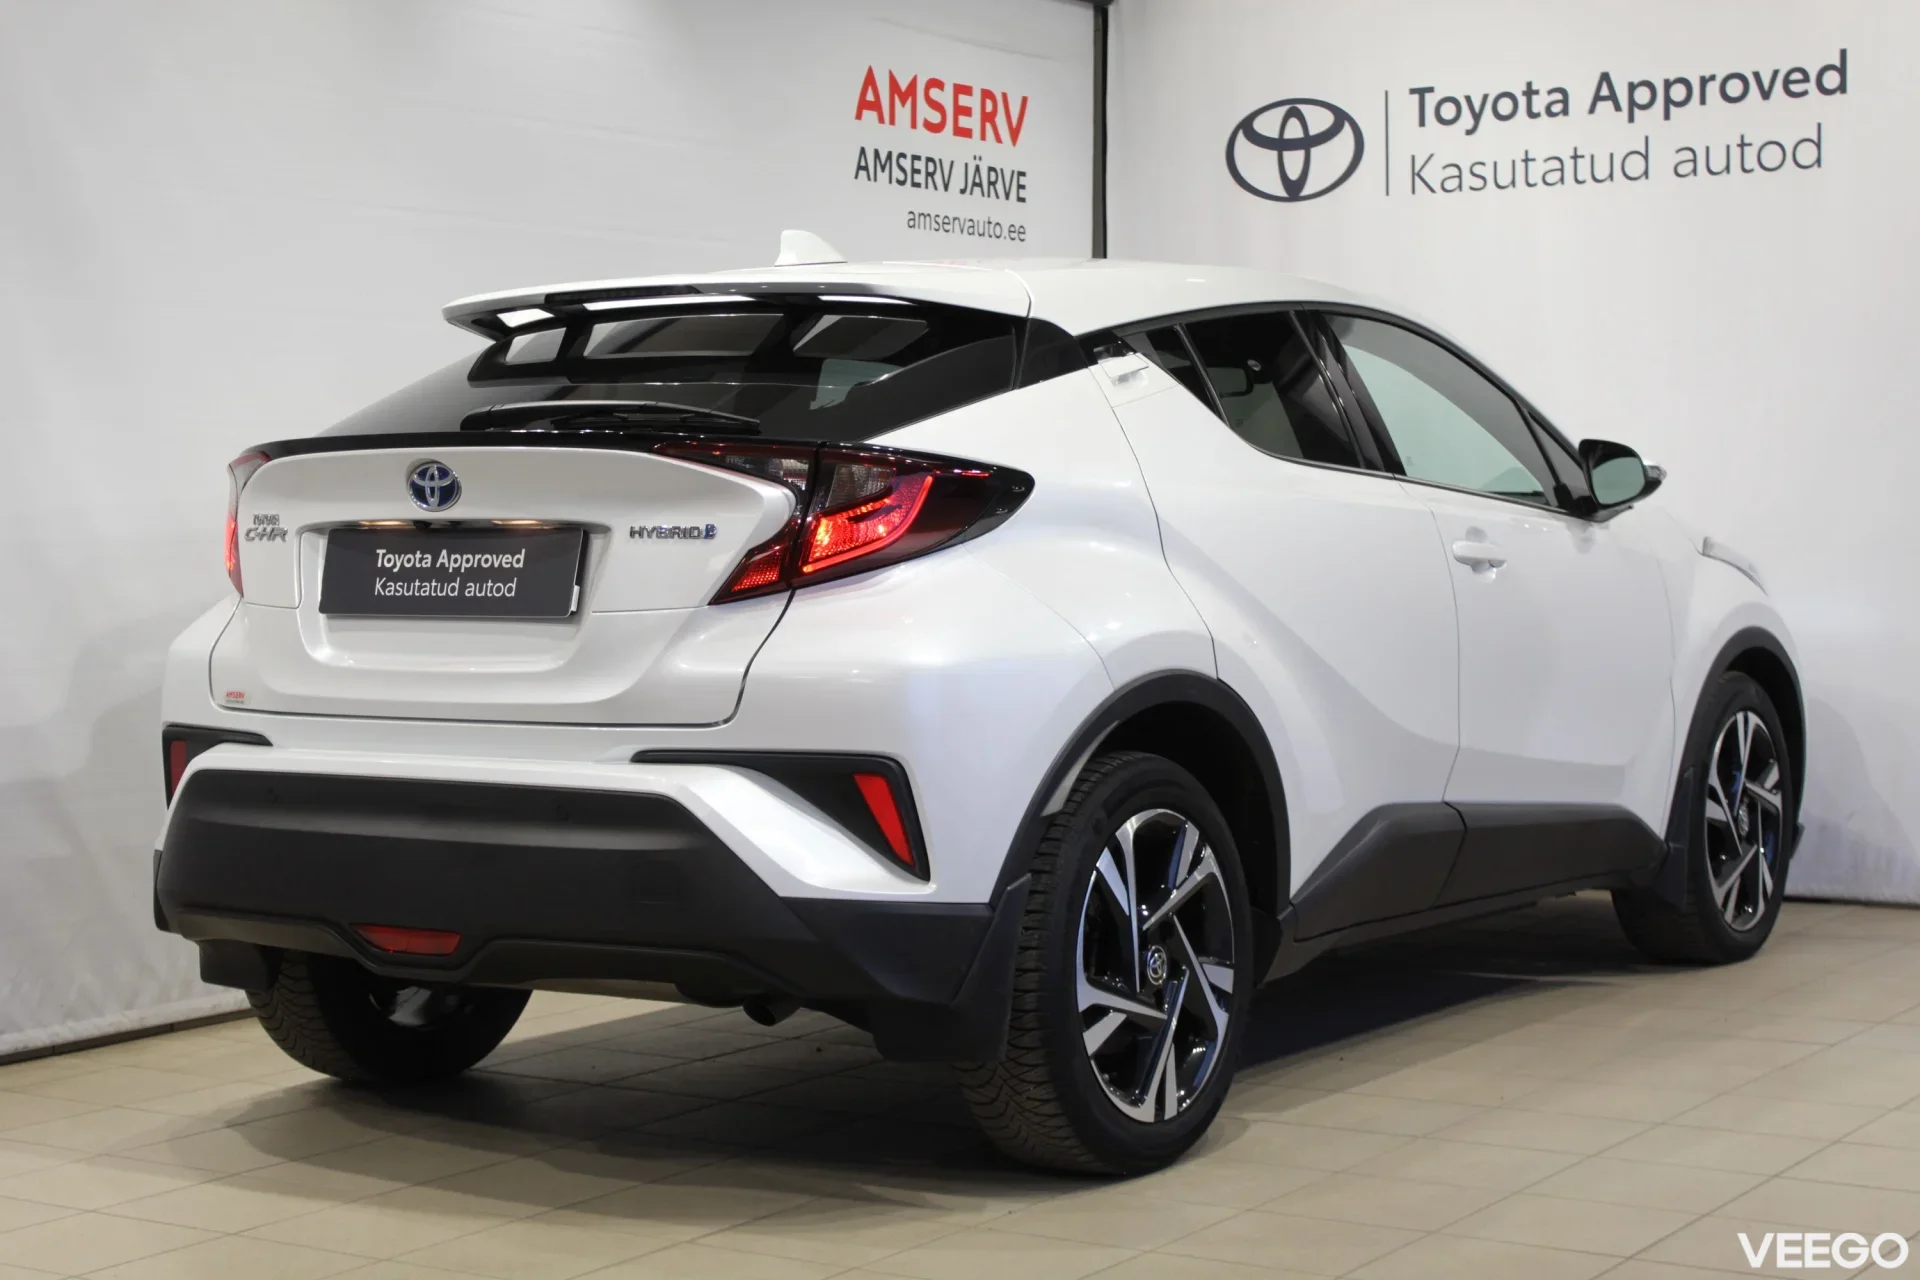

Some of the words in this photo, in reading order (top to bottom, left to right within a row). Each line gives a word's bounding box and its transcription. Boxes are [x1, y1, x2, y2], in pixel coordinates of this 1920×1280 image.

[855, 64, 1029, 147] AMSERV
[1409, 81, 1570, 135] Toyota
[1588, 48, 1848, 123] Approved
[854, 146, 954, 192] AMSERV
[959, 155, 1027, 203] JÄRVE
[1411, 136, 1650, 195] Kasutatud
[1673, 122, 1823, 178] autod
[906, 210, 1026, 242] amservauto.ee
[629, 525, 703, 539] HYBRID
[376, 549, 432, 572] Toyota
[436, 548, 525, 572] Approved
[375, 577, 460, 596] Kasutatud
[464, 577, 517, 597] autod
